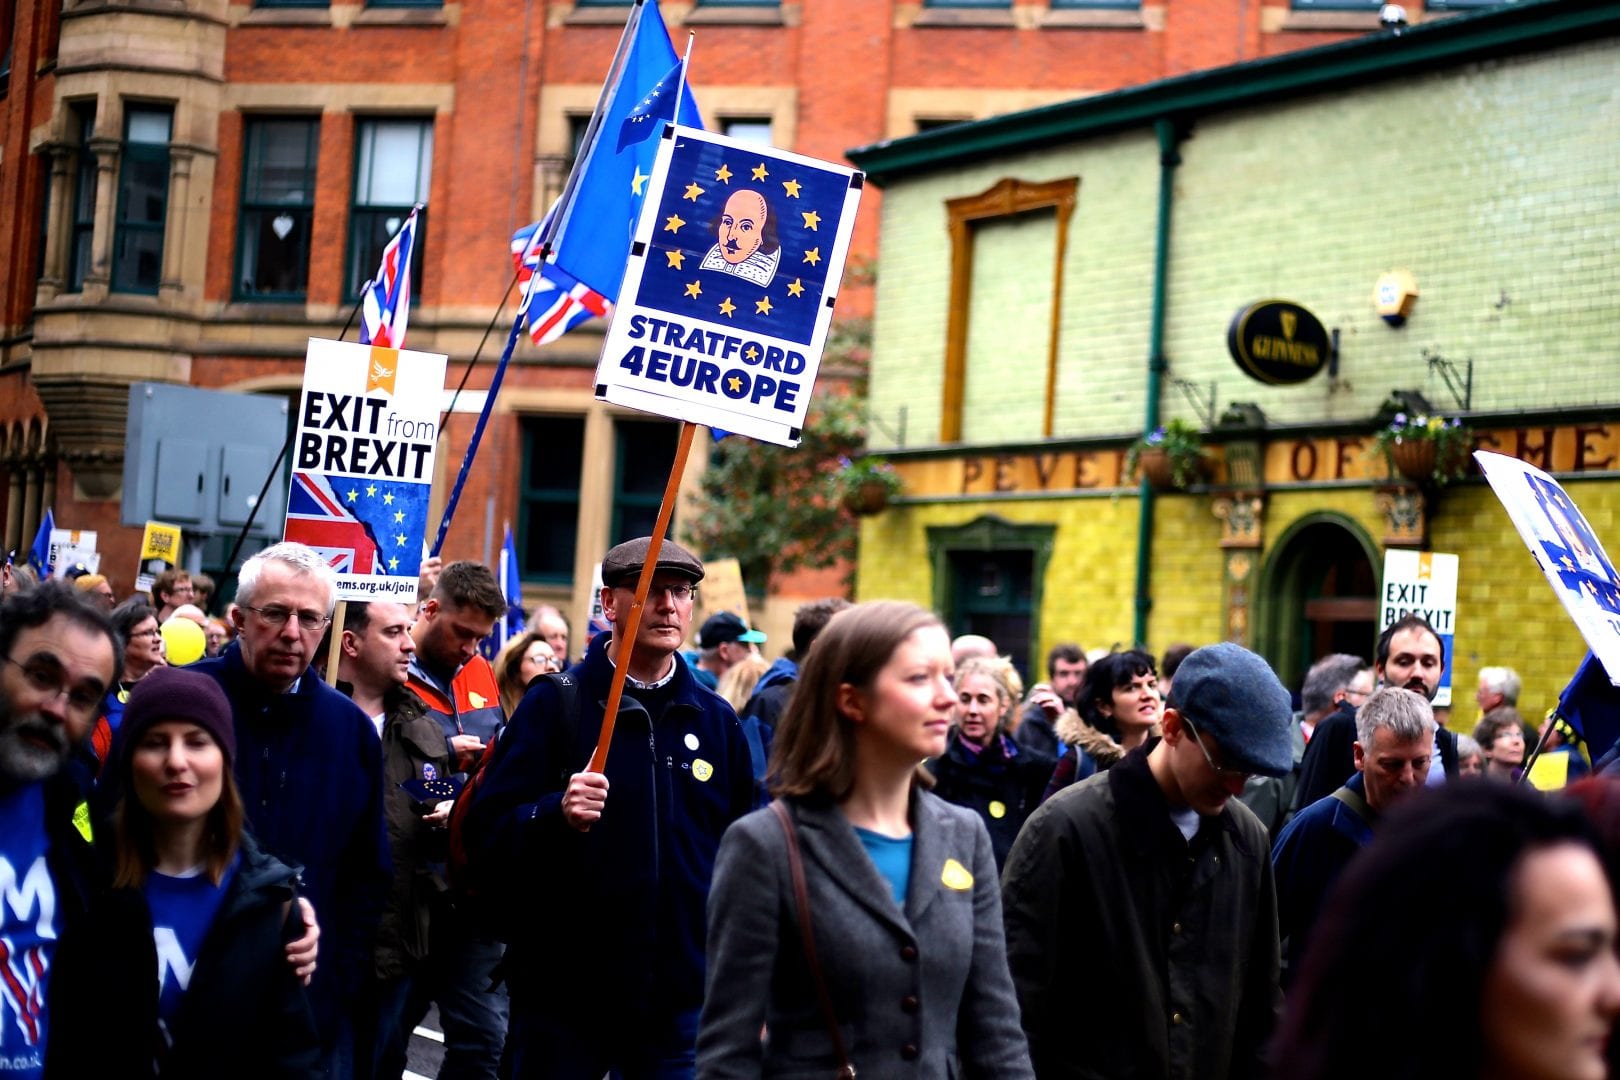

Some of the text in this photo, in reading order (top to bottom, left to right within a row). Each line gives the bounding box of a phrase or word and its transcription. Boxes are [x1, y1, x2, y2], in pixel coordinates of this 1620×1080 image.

[628, 314, 806, 376] STRATFORD
[620, 345, 801, 413] 4EUROPE
[303, 390, 434, 440] EXIT from
[297, 432, 432, 479] BREXIT
[1291, 436, 1365, 480] OF
[1386, 583, 1428, 604] EXIT
